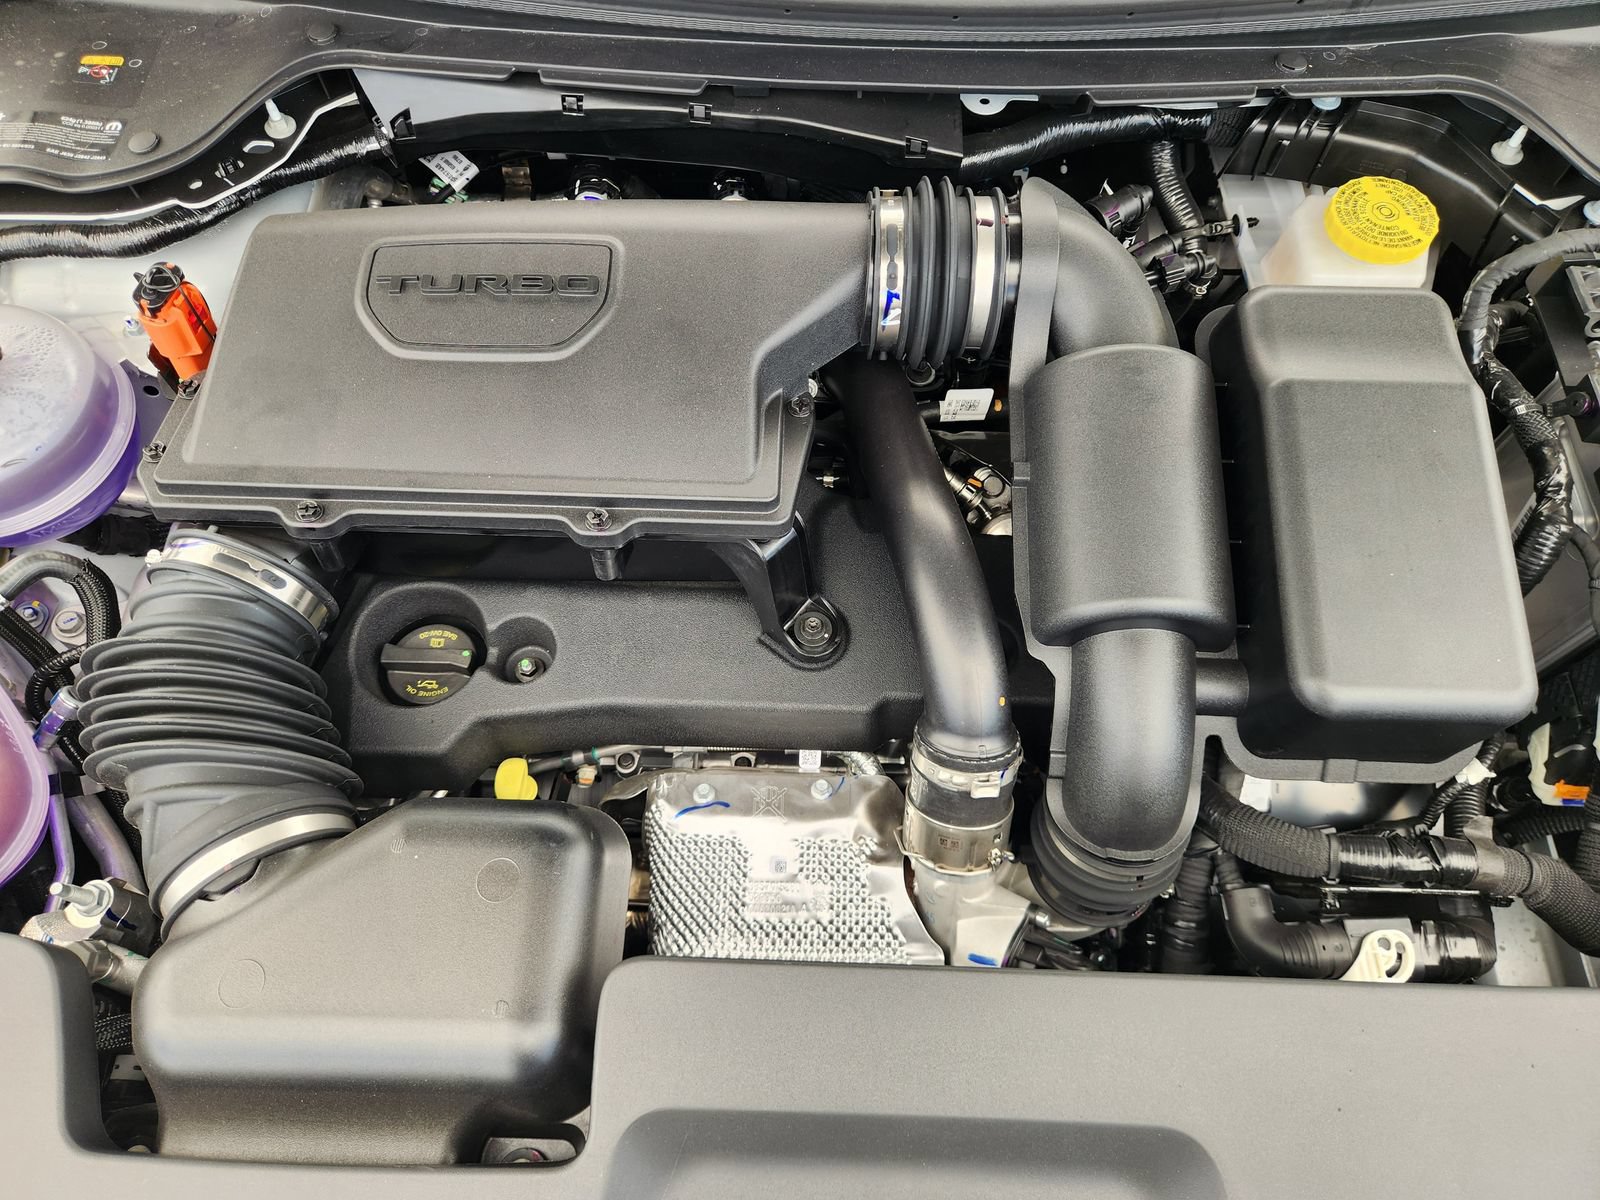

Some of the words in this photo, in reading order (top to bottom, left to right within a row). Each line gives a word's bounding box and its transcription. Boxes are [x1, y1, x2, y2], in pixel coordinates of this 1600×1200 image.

[1362, 215, 1401, 231] CONTENANT
[1363, 224, 1376, 233] DOT
[376, 274, 600, 296] TURBO
[420, 630, 442, 640] 0W-20
[442, 630, 458, 640] SAE
[406, 684, 418, 694] OIL
[418, 686, 449, 697] ENGINE
